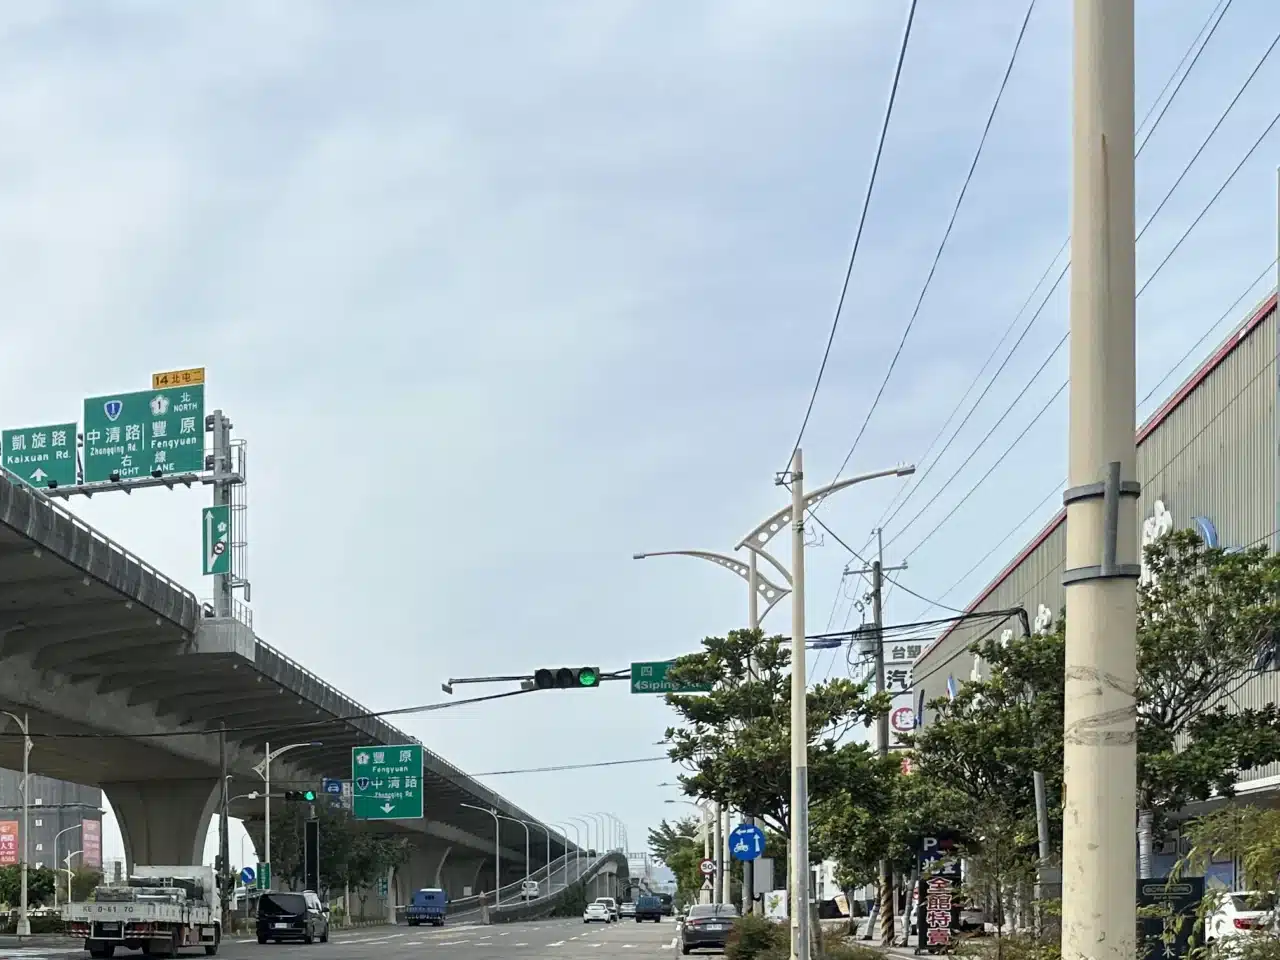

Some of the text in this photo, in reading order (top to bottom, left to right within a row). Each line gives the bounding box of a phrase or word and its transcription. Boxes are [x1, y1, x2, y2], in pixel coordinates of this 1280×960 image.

[156, 370, 202, 386] 14 北屯二
[180, 392, 191, 403] 北
[173, 402, 198, 412] NORTH
[152, 416, 196, 438] 豐原
[11, 430, 67, 451] 凱旋路
[86, 424, 140, 445] 中清路
[127, 443, 138, 452] Rd.
[151, 437, 197, 449] Fengyuan
[7, 450, 71, 465] Kaixuan Rd.
[121, 455, 132, 467] 右
[150, 463, 175, 474] LANE
[372, 766, 408, 774] Fengyuan
[923, 837, 938, 851] P
